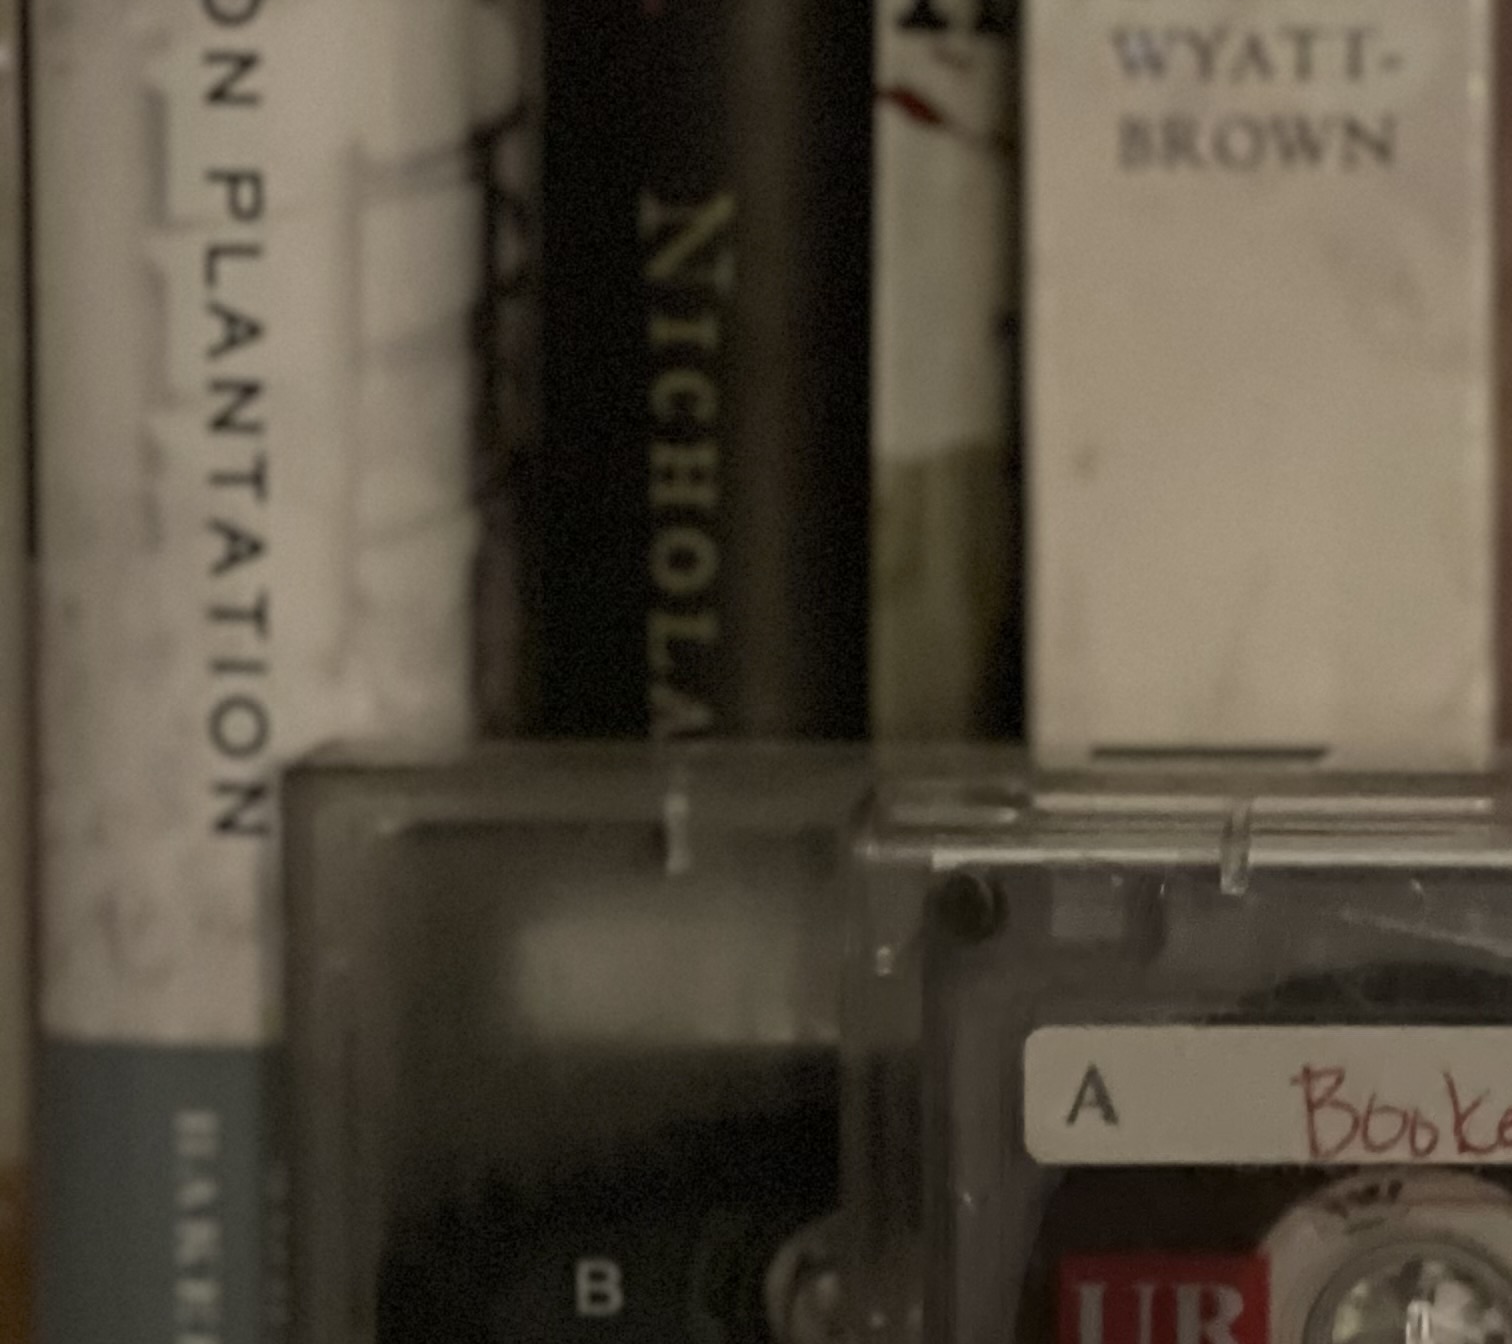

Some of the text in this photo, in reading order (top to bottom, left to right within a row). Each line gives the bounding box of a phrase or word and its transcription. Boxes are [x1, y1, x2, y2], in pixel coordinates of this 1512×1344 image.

[1110, 26, 1405, 83] WYATT-
[1116, 114, 1399, 173] BROWN
[202, 169, 275, 840] PLANTATION
[1065, 1063, 1119, 1126] A
[574, 1258, 623, 1317] B
